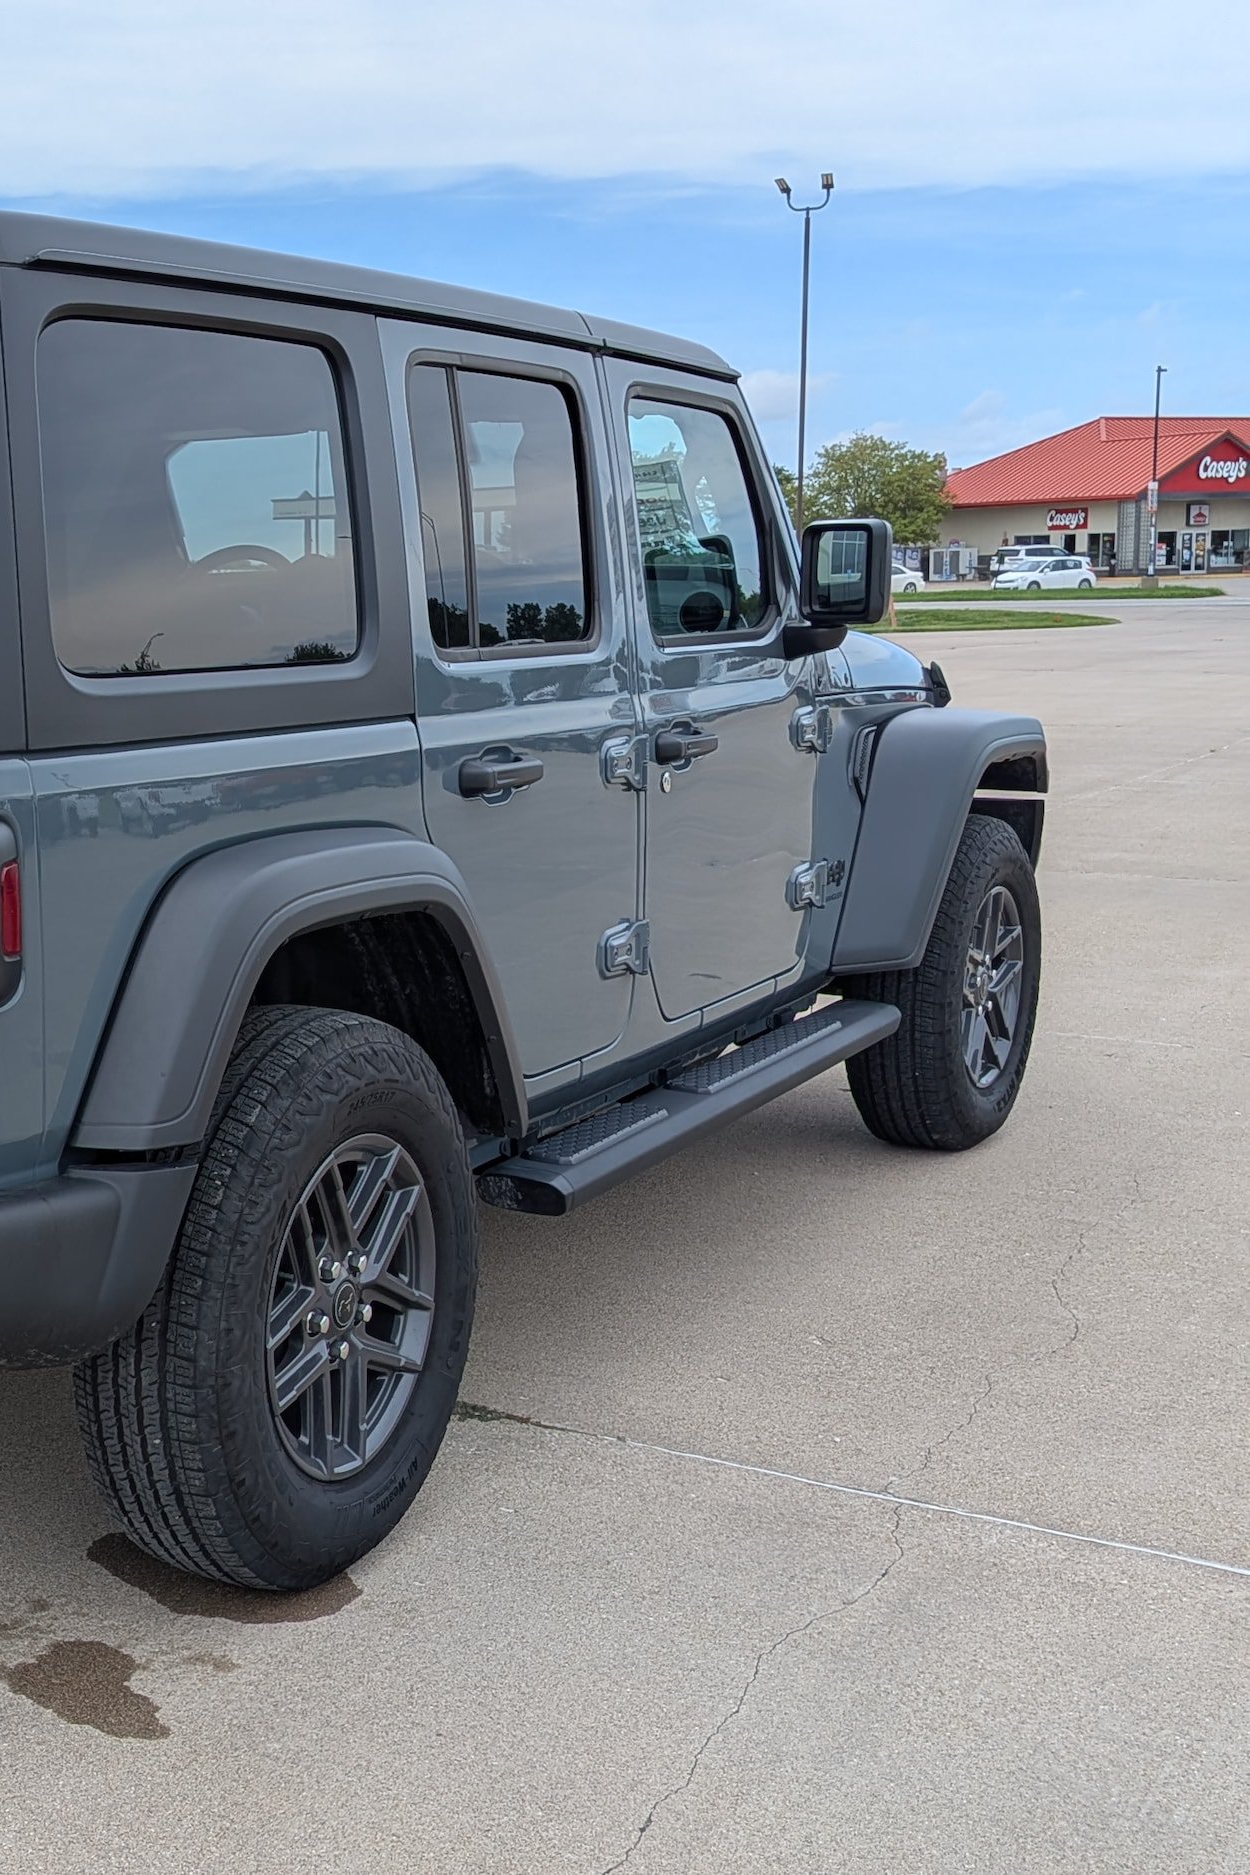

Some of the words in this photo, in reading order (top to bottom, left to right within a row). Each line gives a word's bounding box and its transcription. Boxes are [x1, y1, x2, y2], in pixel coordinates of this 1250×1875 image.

[1198, 456, 1247, 483] Casey's
[1047, 509, 1085, 529] Casey's
[372, 1456, 418, 1518] All-Weather
